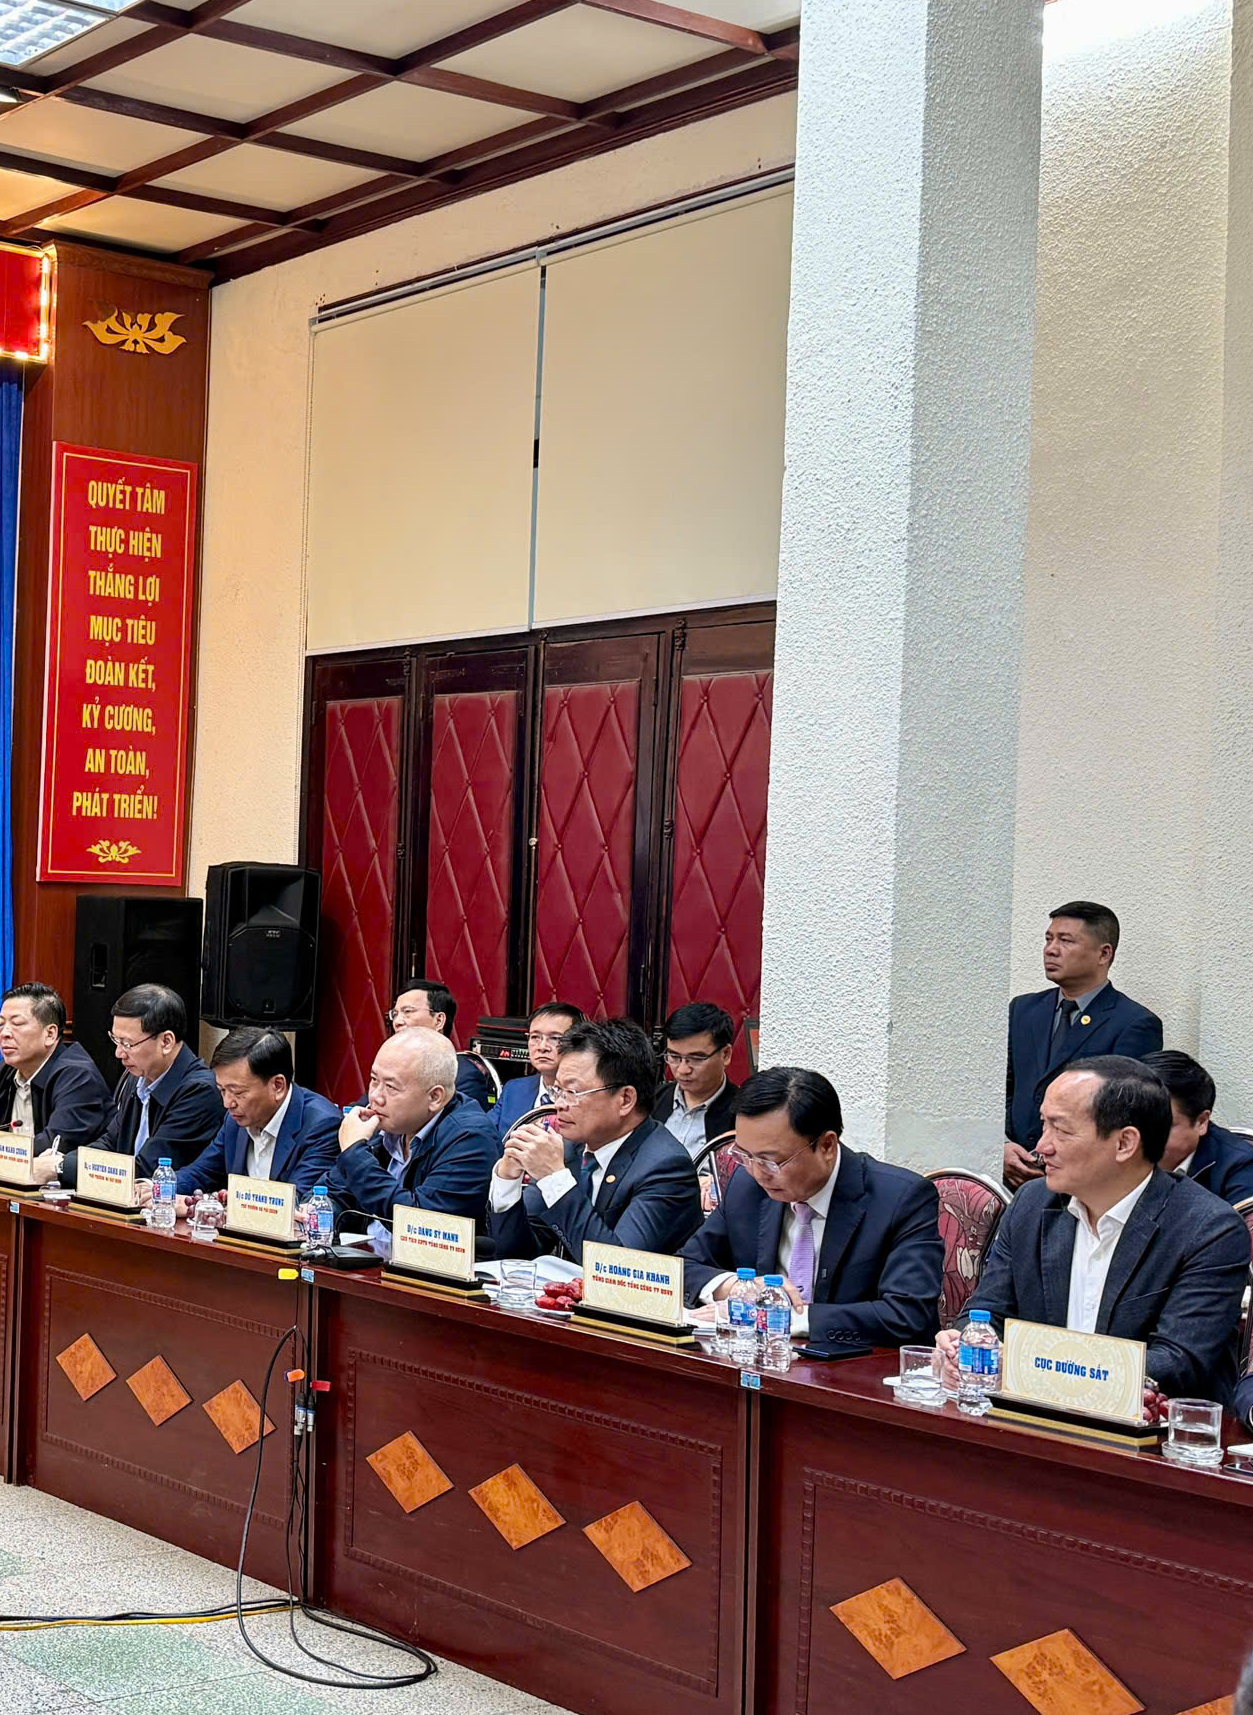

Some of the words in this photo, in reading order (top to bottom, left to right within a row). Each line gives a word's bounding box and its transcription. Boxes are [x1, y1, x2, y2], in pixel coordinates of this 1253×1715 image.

[88, 476, 131, 511] QUYẾT
[136, 481, 165, 515] TÂM
[89, 525, 125, 558] THỰC
[129, 528, 162, 562] HIỆN
[88, 563, 135, 600] THẮNG
[138, 573, 160, 606] LỢI
[90, 615, 122, 647] MỤC
[126, 614, 156, 646] TIÊU
[85, 656, 125, 687] ĐOÀN
[129, 656, 156, 692] KẾT,
[82, 695, 101, 730] KỶ
[105, 702, 156, 735] CƯƠNG,
[85, 748, 106, 774] AN
[110, 744, 150, 779] TOÀN,
[72, 787, 109, 818] PHÁT
[113, 784, 158, 820] TRIỂN!
[1035, 1356, 1053, 1372] CỤC
[1055, 1360, 1087, 1377] ĐƯỜNG
[1089, 1363, 1109, 1382] SẮT
